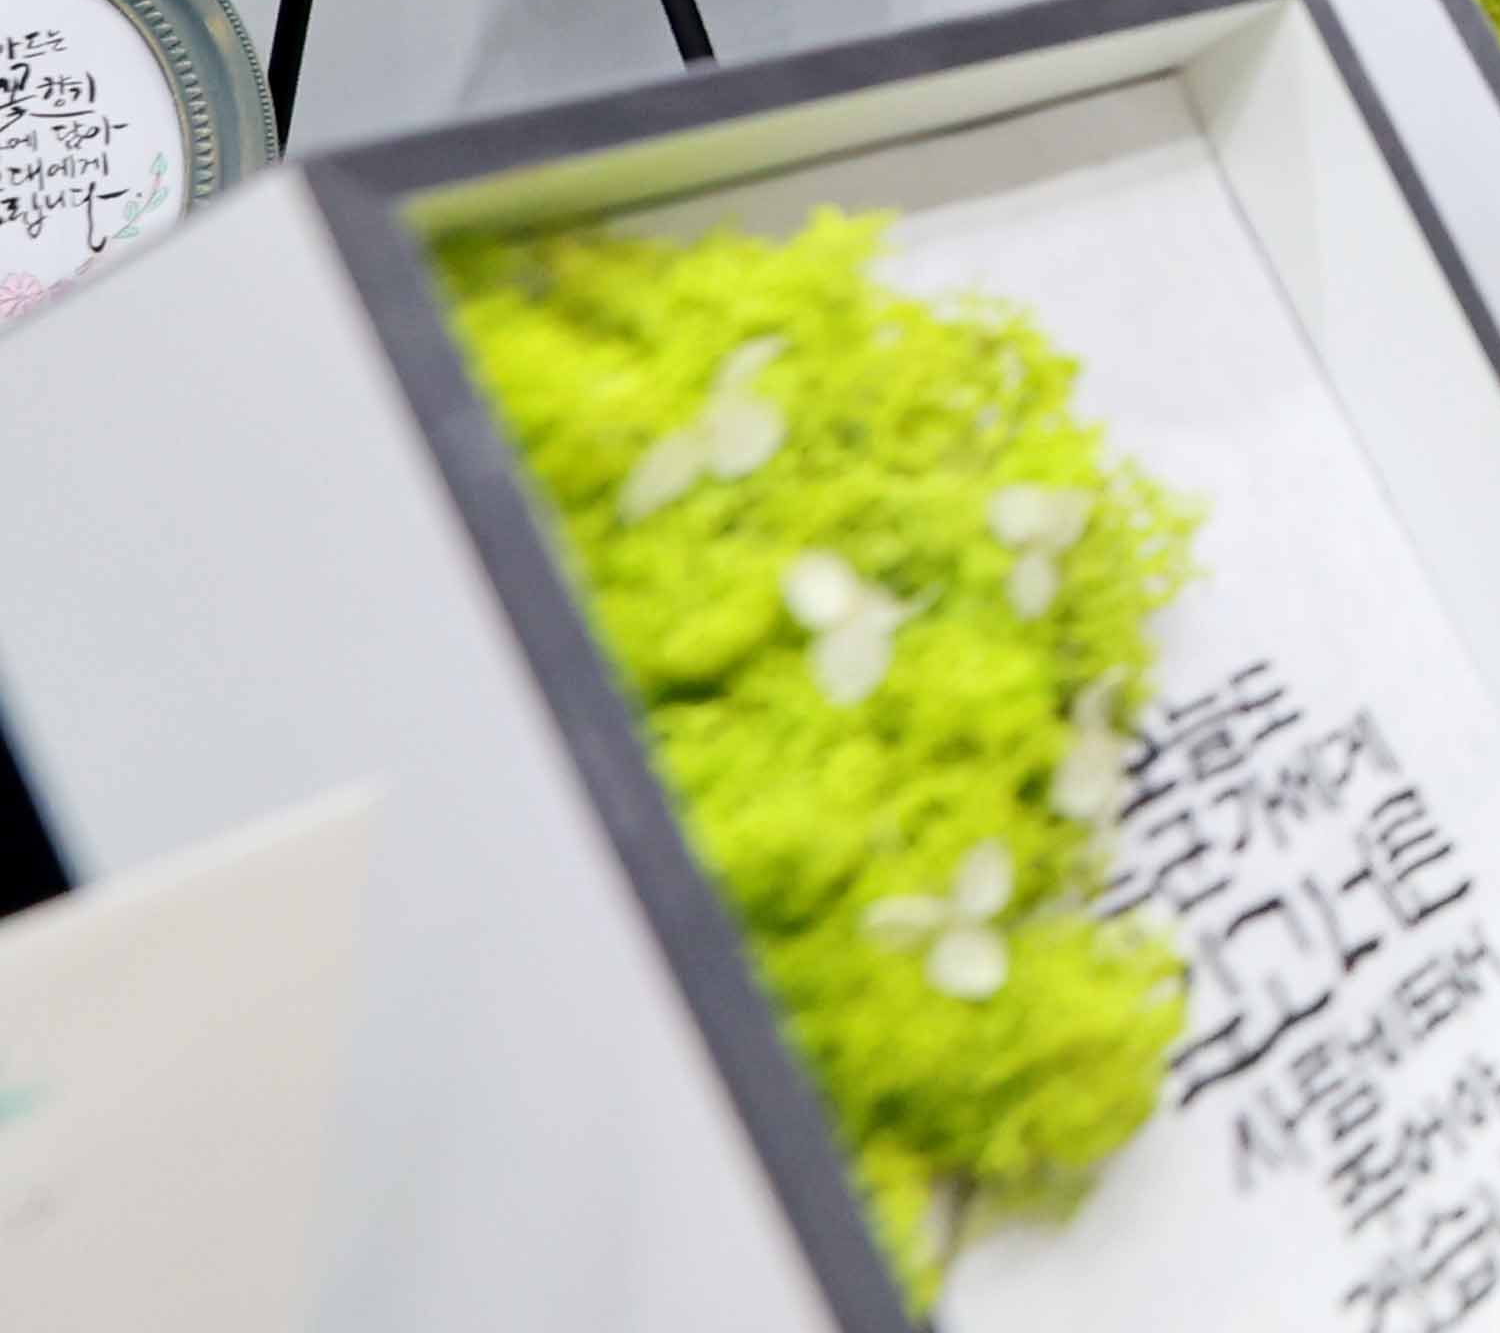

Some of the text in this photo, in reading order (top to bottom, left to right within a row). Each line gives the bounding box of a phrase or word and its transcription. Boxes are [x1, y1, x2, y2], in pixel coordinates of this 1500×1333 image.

[52, 115, 129, 150] 담아
[0, 152, 109, 191] 대에게
[0, 182, 142, 252] 립니다.
